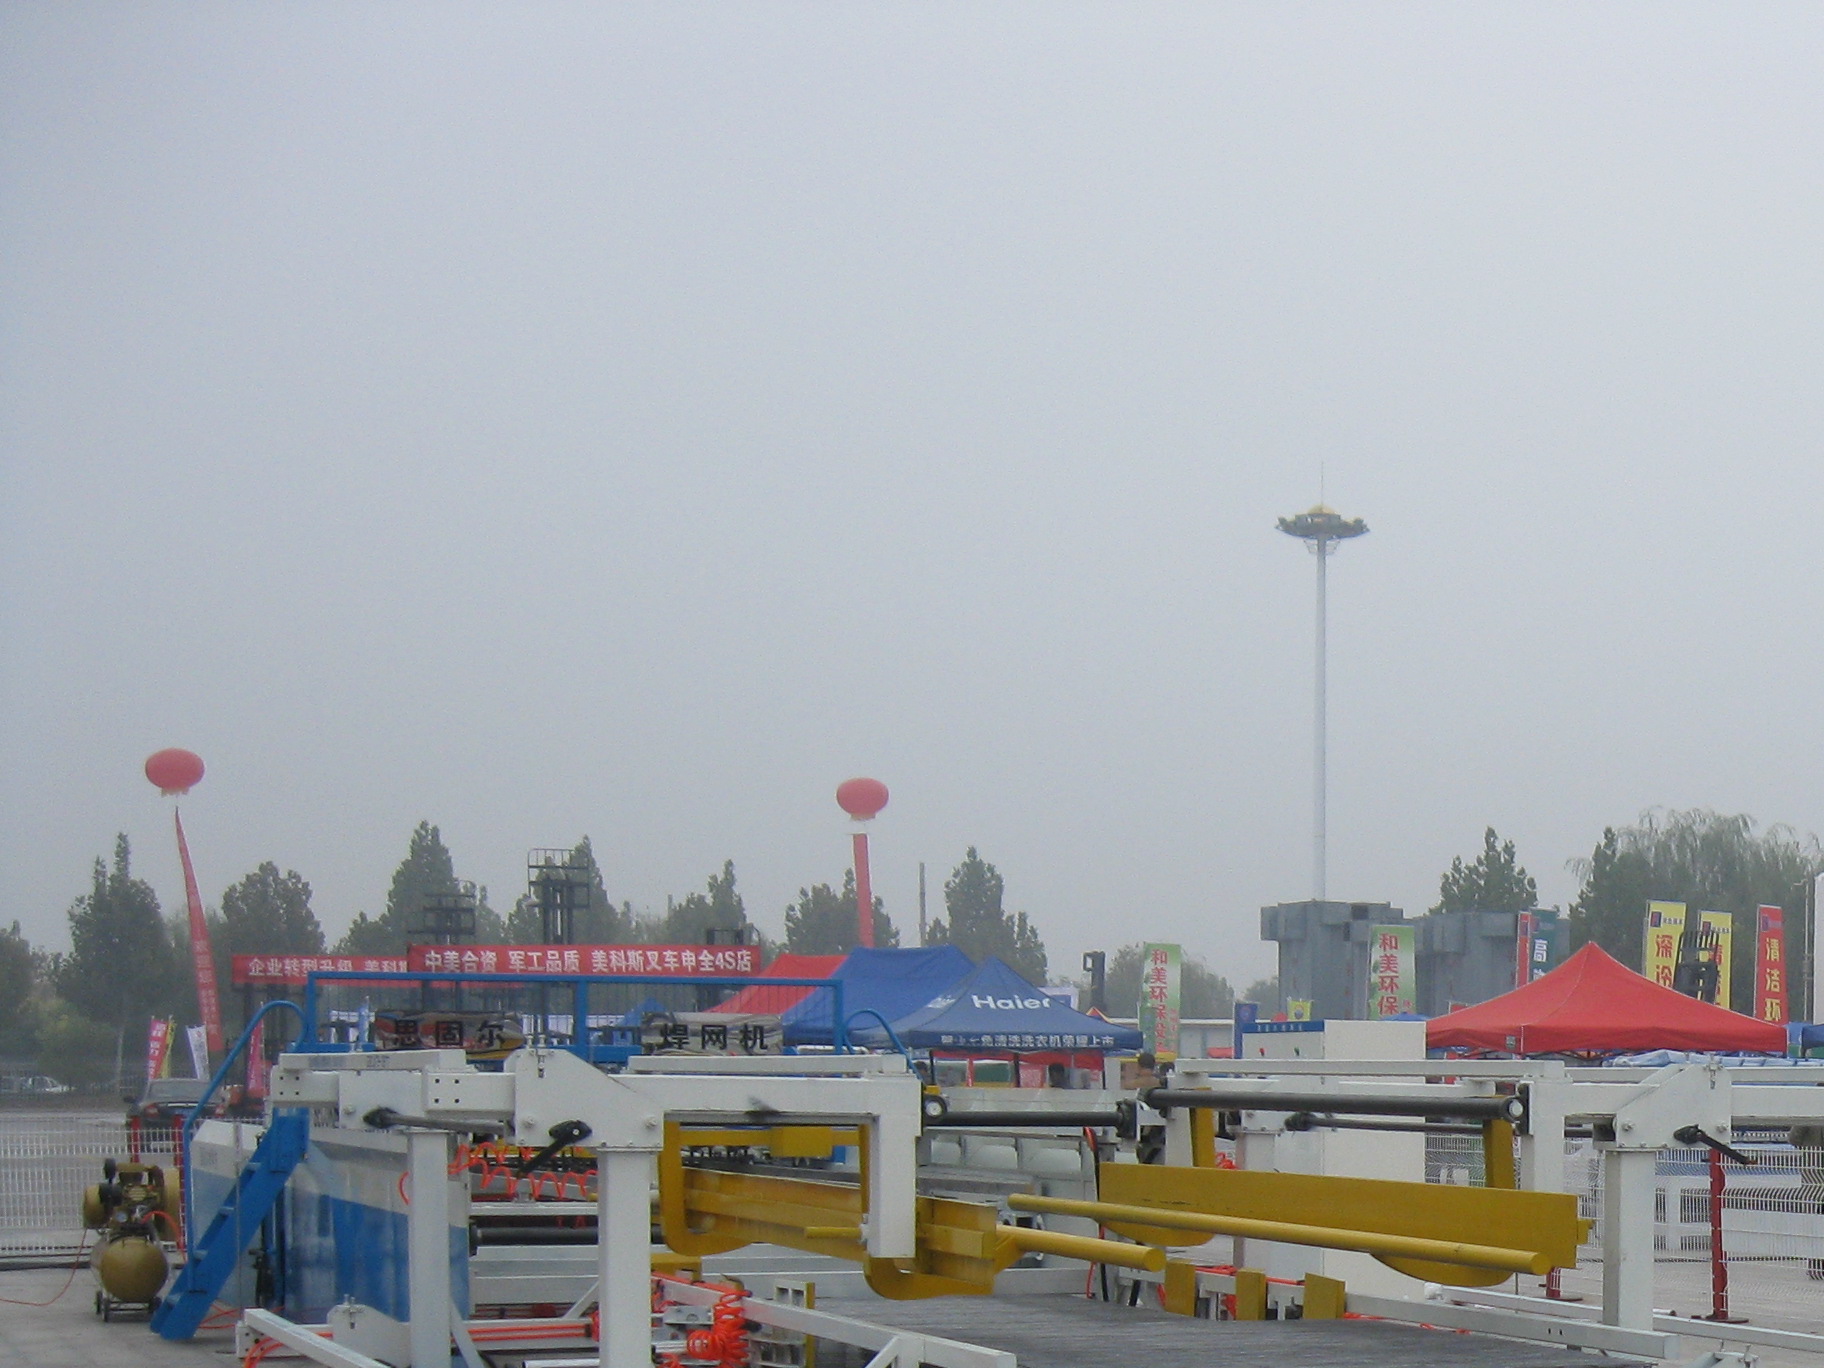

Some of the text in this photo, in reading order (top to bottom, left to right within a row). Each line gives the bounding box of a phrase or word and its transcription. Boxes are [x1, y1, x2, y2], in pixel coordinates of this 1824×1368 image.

[424, 949, 753, 973] 中美合资 军工品质 美科斯叉车申全4S店
[1376, 932, 1400, 1015] 和美环保
[971, 993, 1052, 1010] Haier
[394, 1019, 769, 1052] 思固尔 焊网机
